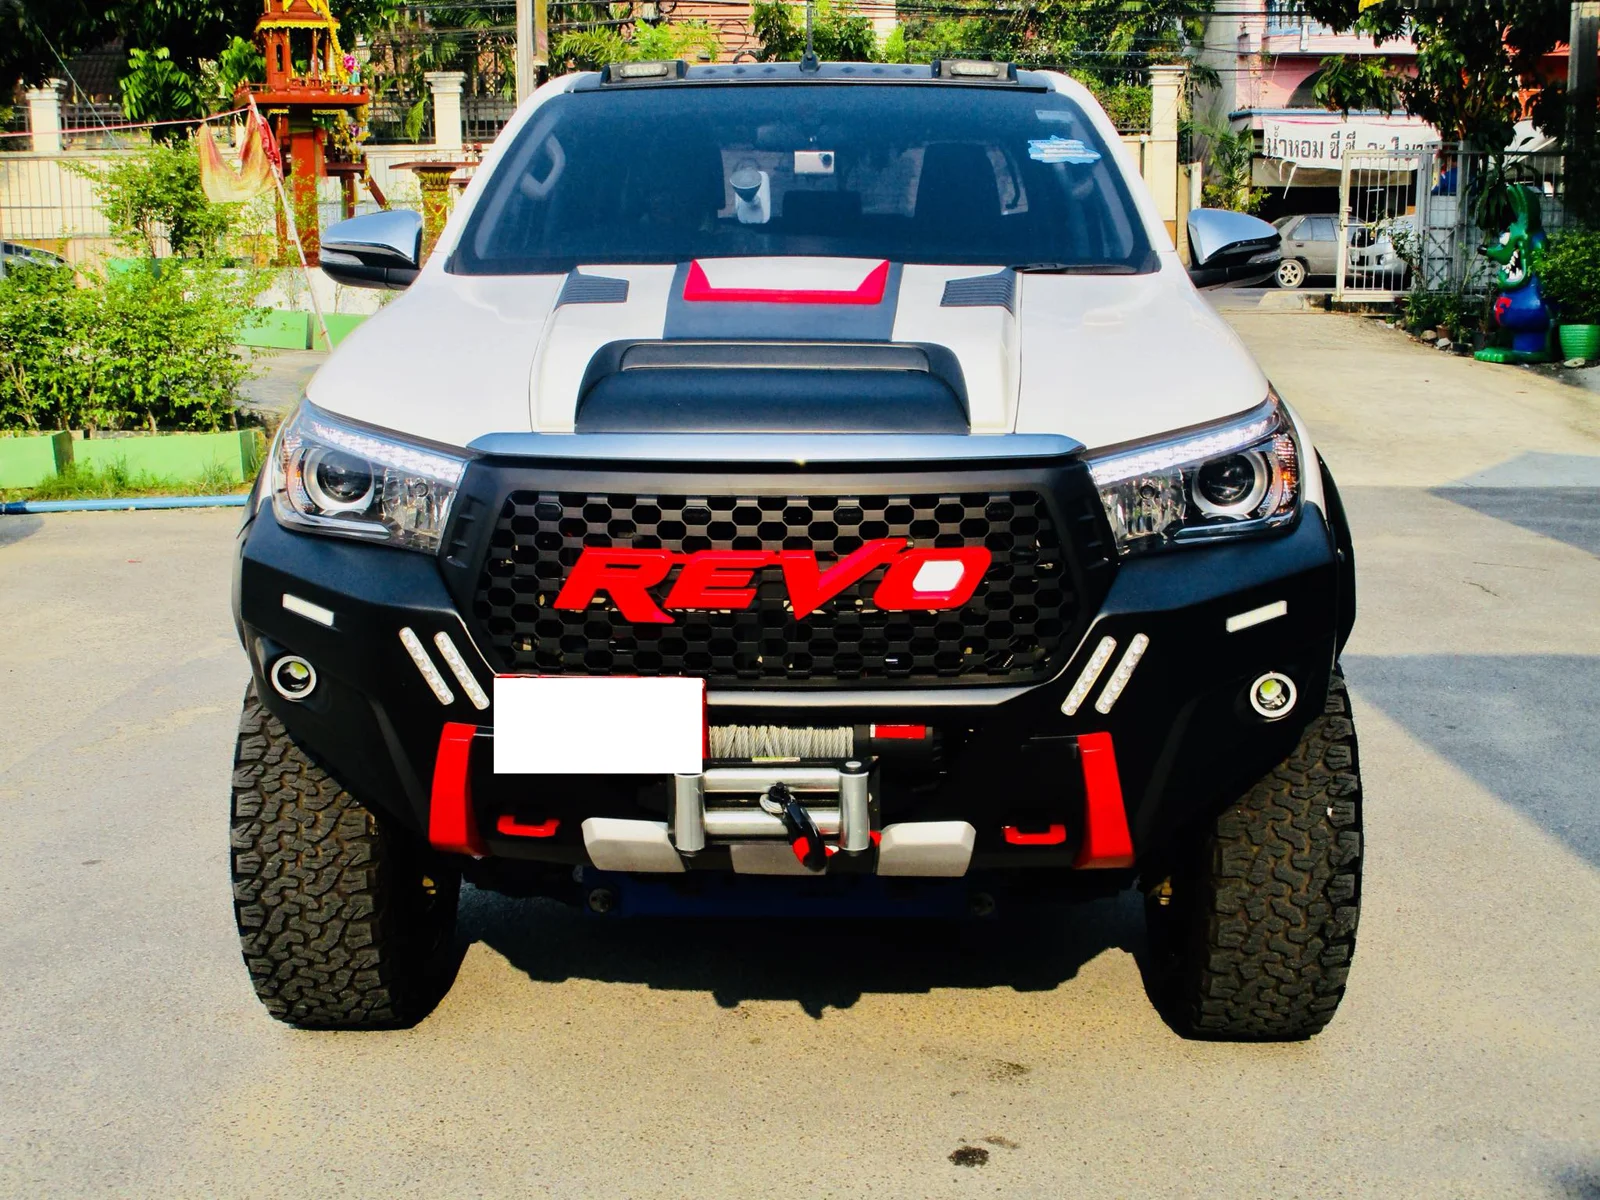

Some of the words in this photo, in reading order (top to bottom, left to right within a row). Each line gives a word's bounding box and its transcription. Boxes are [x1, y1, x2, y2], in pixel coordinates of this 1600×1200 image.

[1265, 124, 1324, 159] น้ำหอม
[553, 537, 992, 624] REVO
